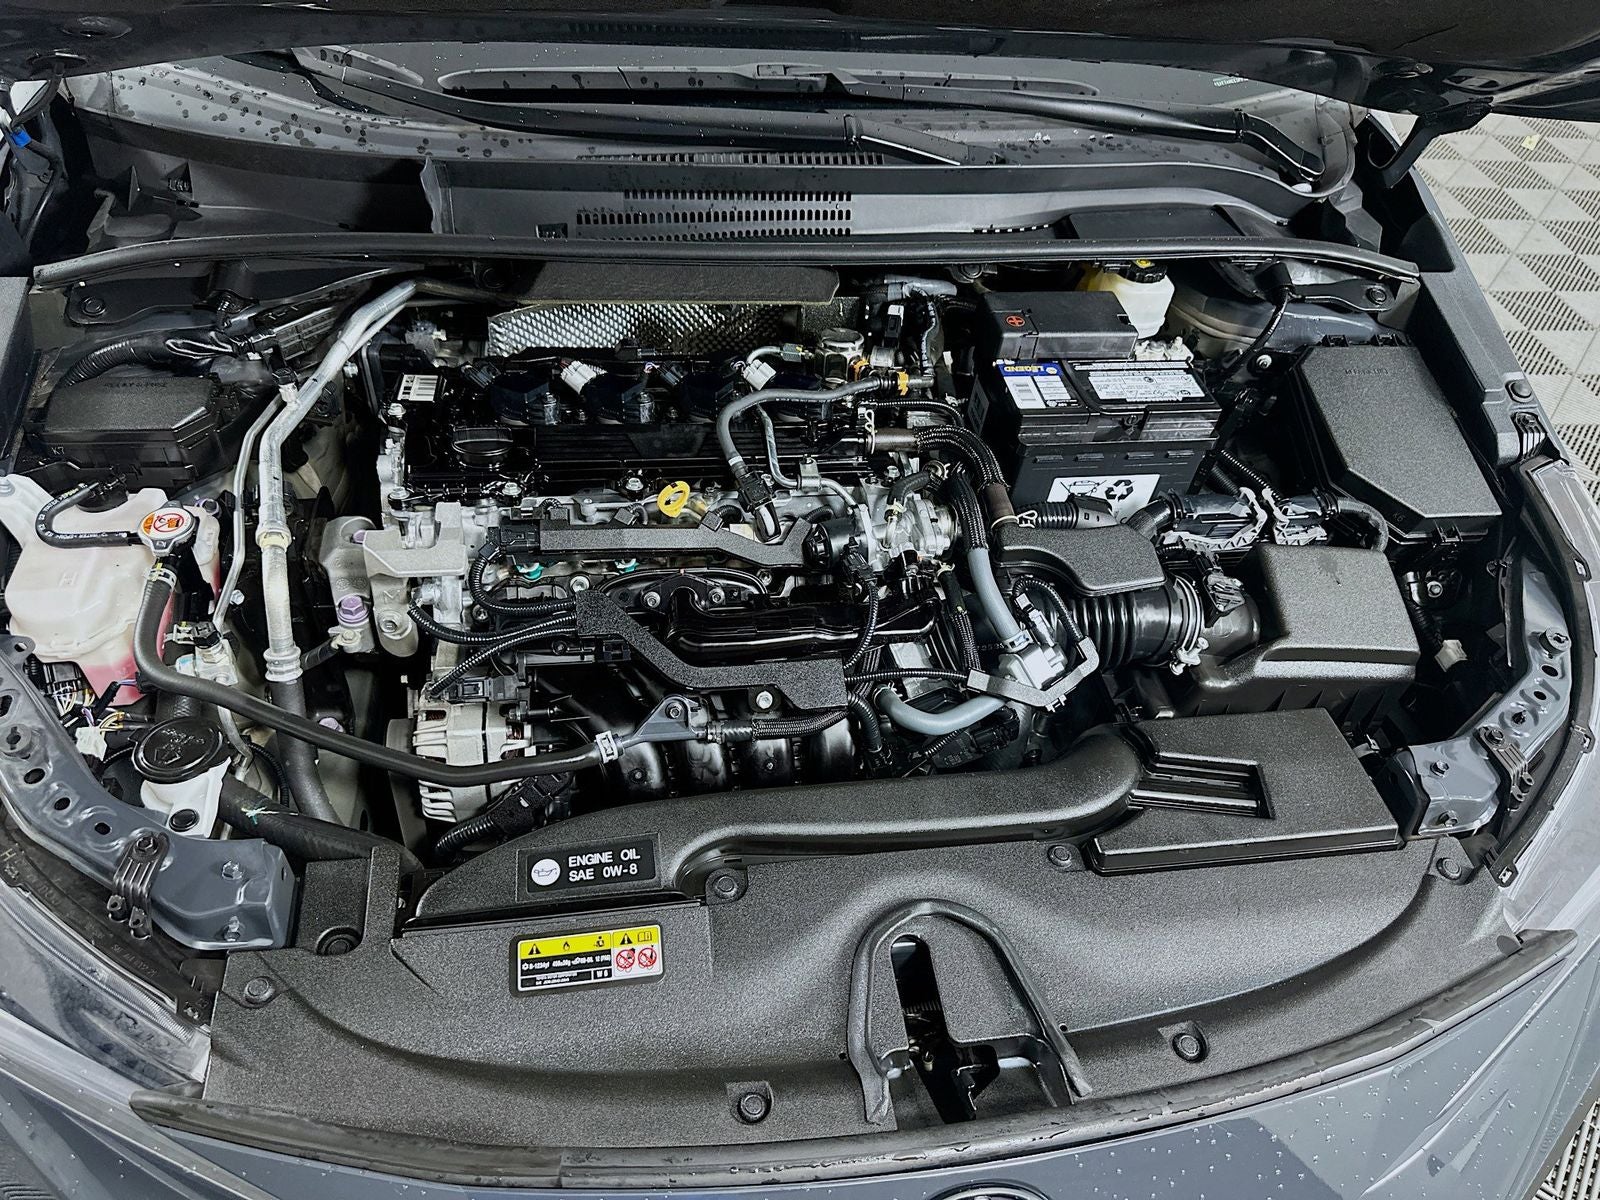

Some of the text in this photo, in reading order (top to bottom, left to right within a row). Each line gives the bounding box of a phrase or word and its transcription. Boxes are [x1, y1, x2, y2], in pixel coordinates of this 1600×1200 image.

[1003, 365, 1044, 373] LEGEND
[568, 848, 641, 868] ENGINE OIL
[568, 863, 638, 882] SAE 0W-8
